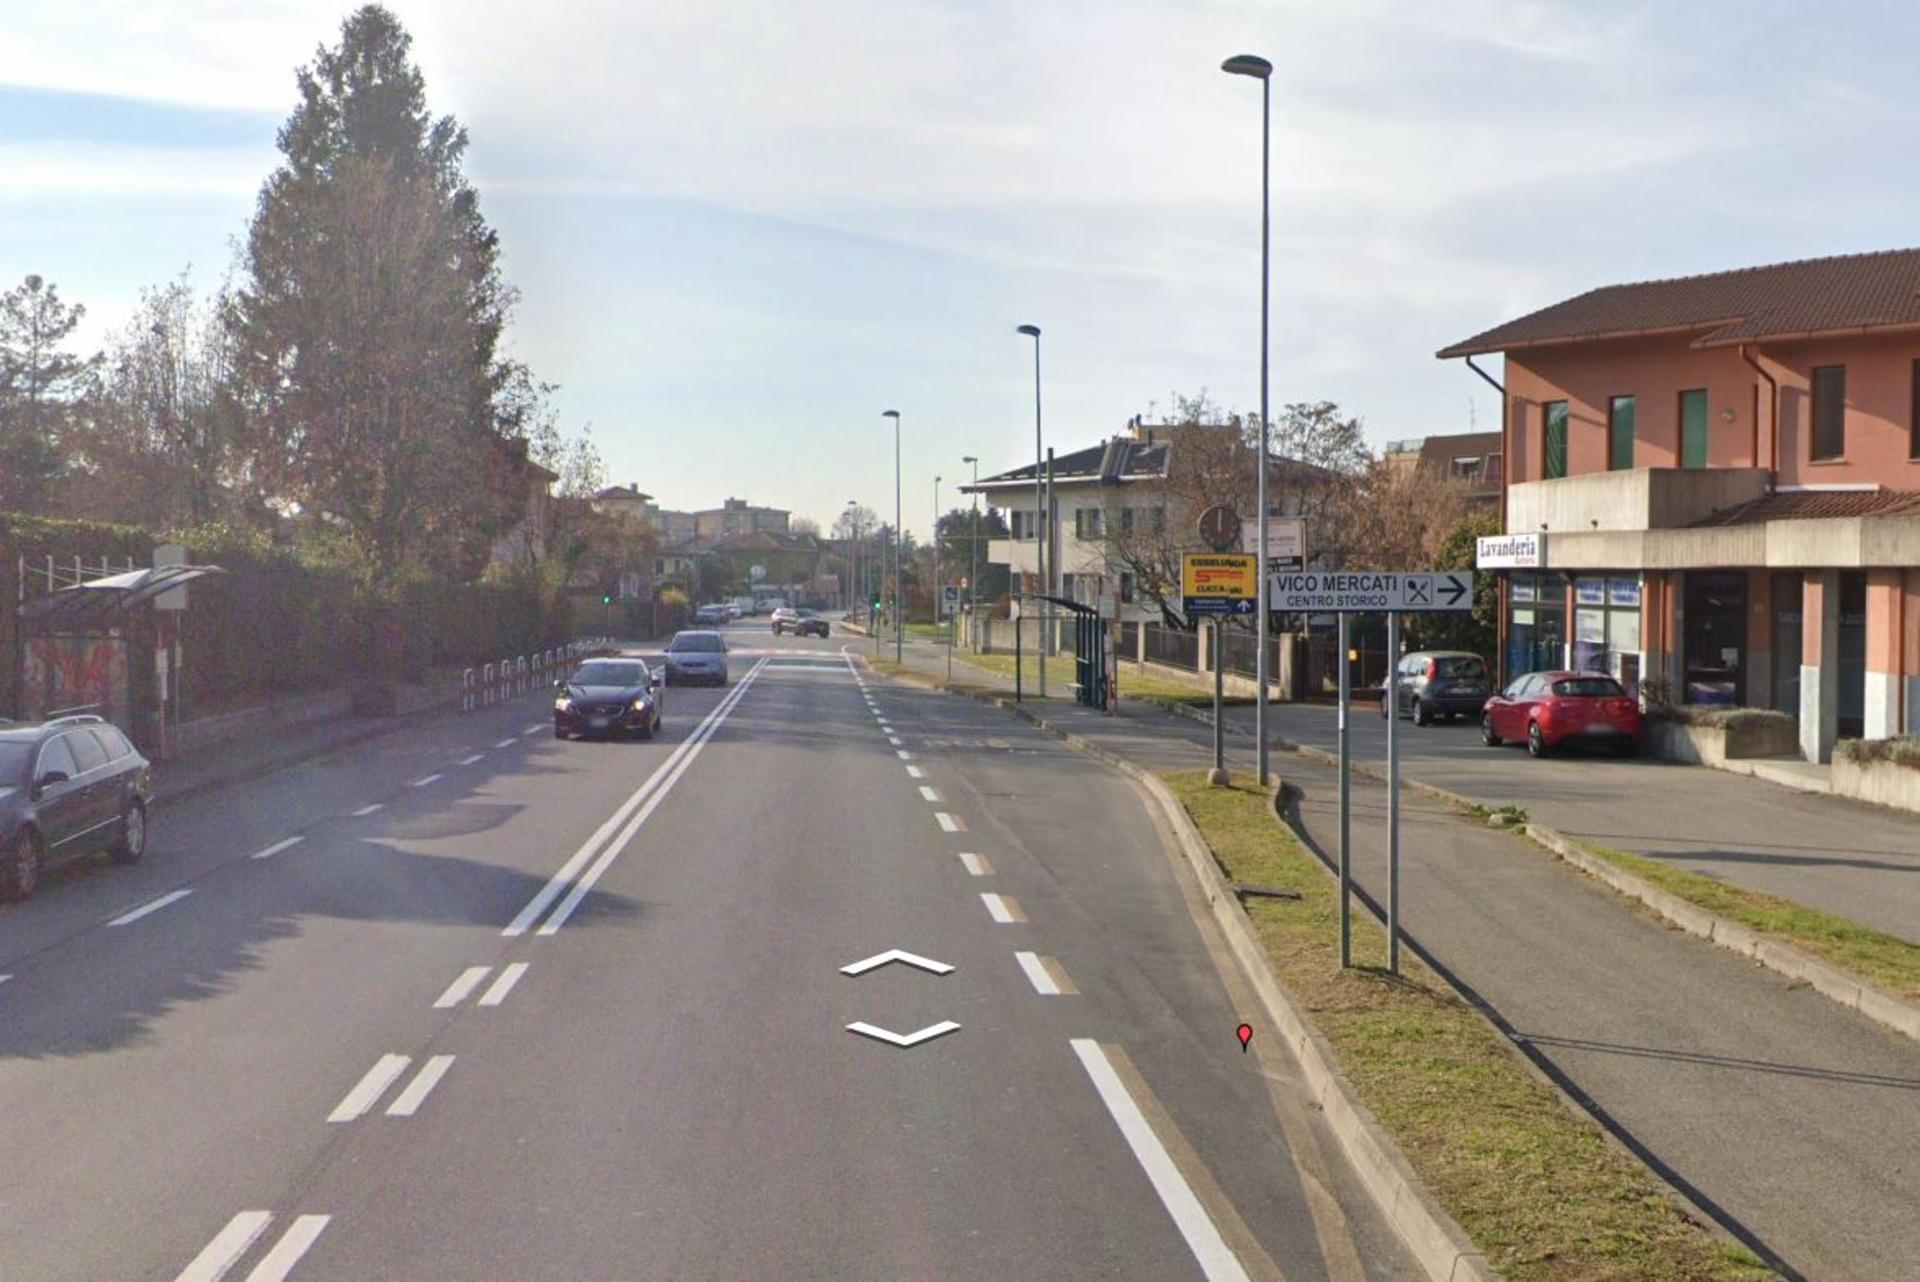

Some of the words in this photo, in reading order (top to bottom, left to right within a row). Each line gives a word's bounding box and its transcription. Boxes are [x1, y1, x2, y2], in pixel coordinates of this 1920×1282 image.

[1480, 536, 1535, 557] Lavanderia
[1277, 575, 1318, 592] VICO
[1322, 575, 1398, 591] MERCATI
[1287, 594, 1334, 607] CENTRO
[1336, 594, 1388, 607] STORICO
